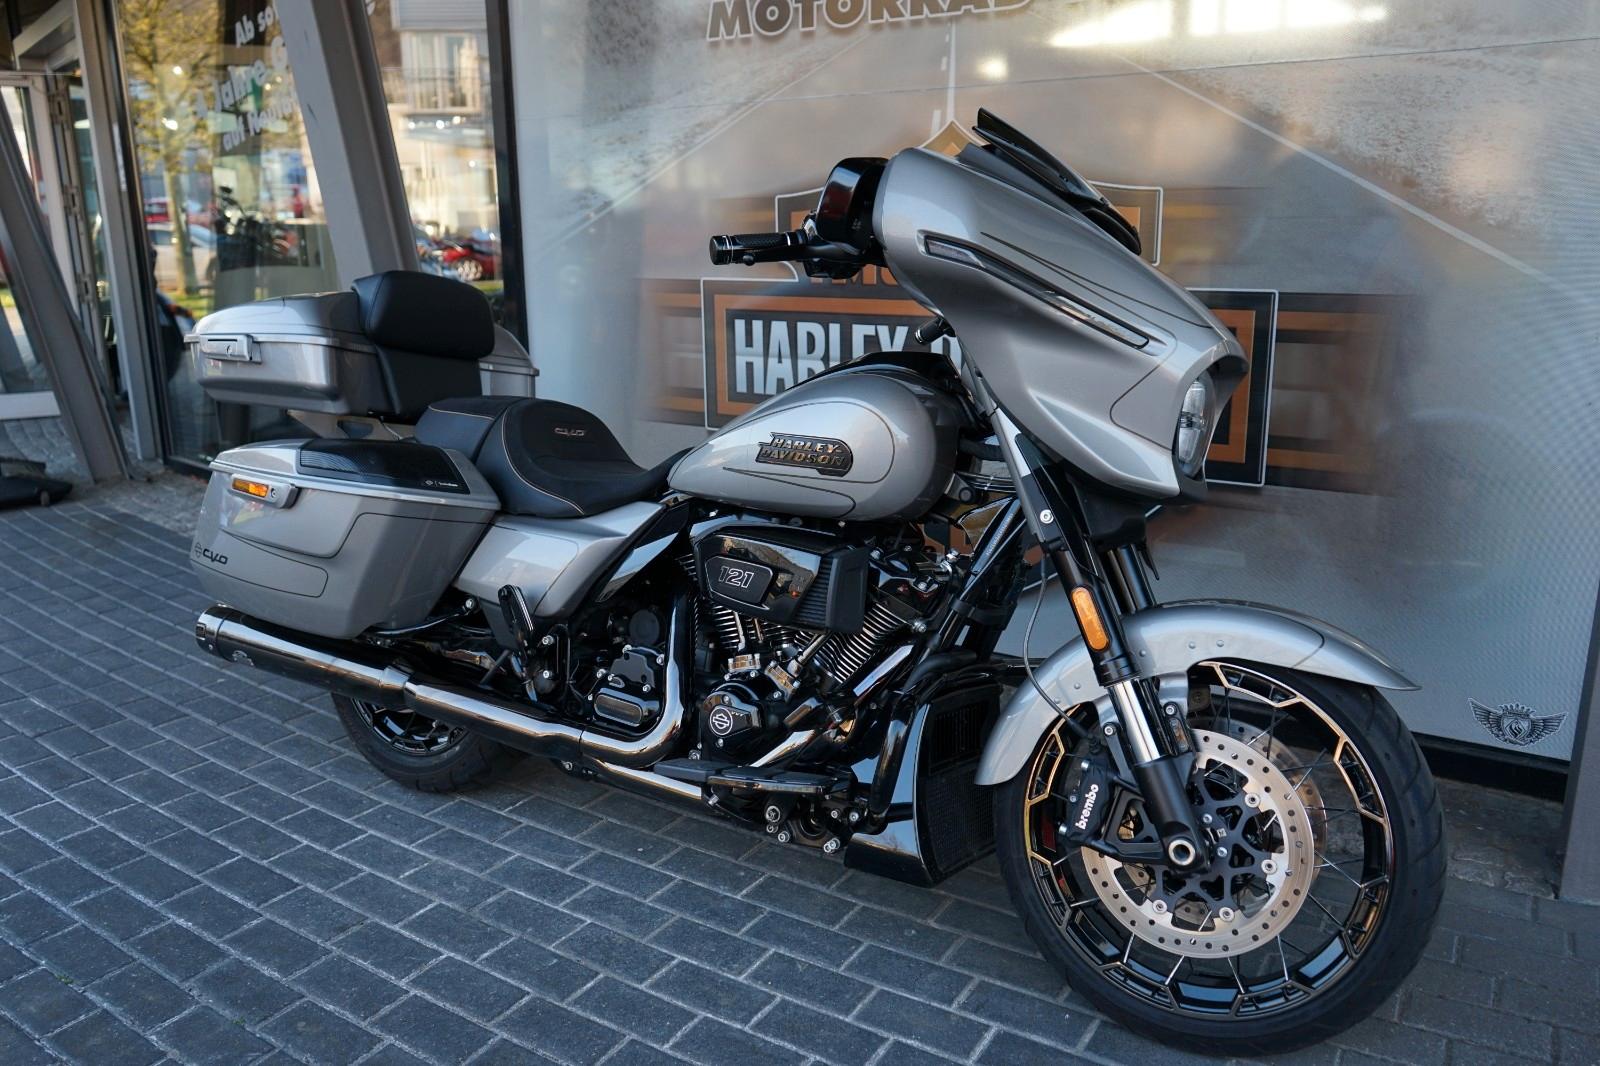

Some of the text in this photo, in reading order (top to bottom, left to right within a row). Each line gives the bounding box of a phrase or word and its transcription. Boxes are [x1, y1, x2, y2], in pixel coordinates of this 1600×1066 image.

[235, 15, 255, 48] Ab
[706, 0, 1031, 41] MOTOR
[718, 565, 754, 588] 121
[1075, 784, 1099, 830] brembo
